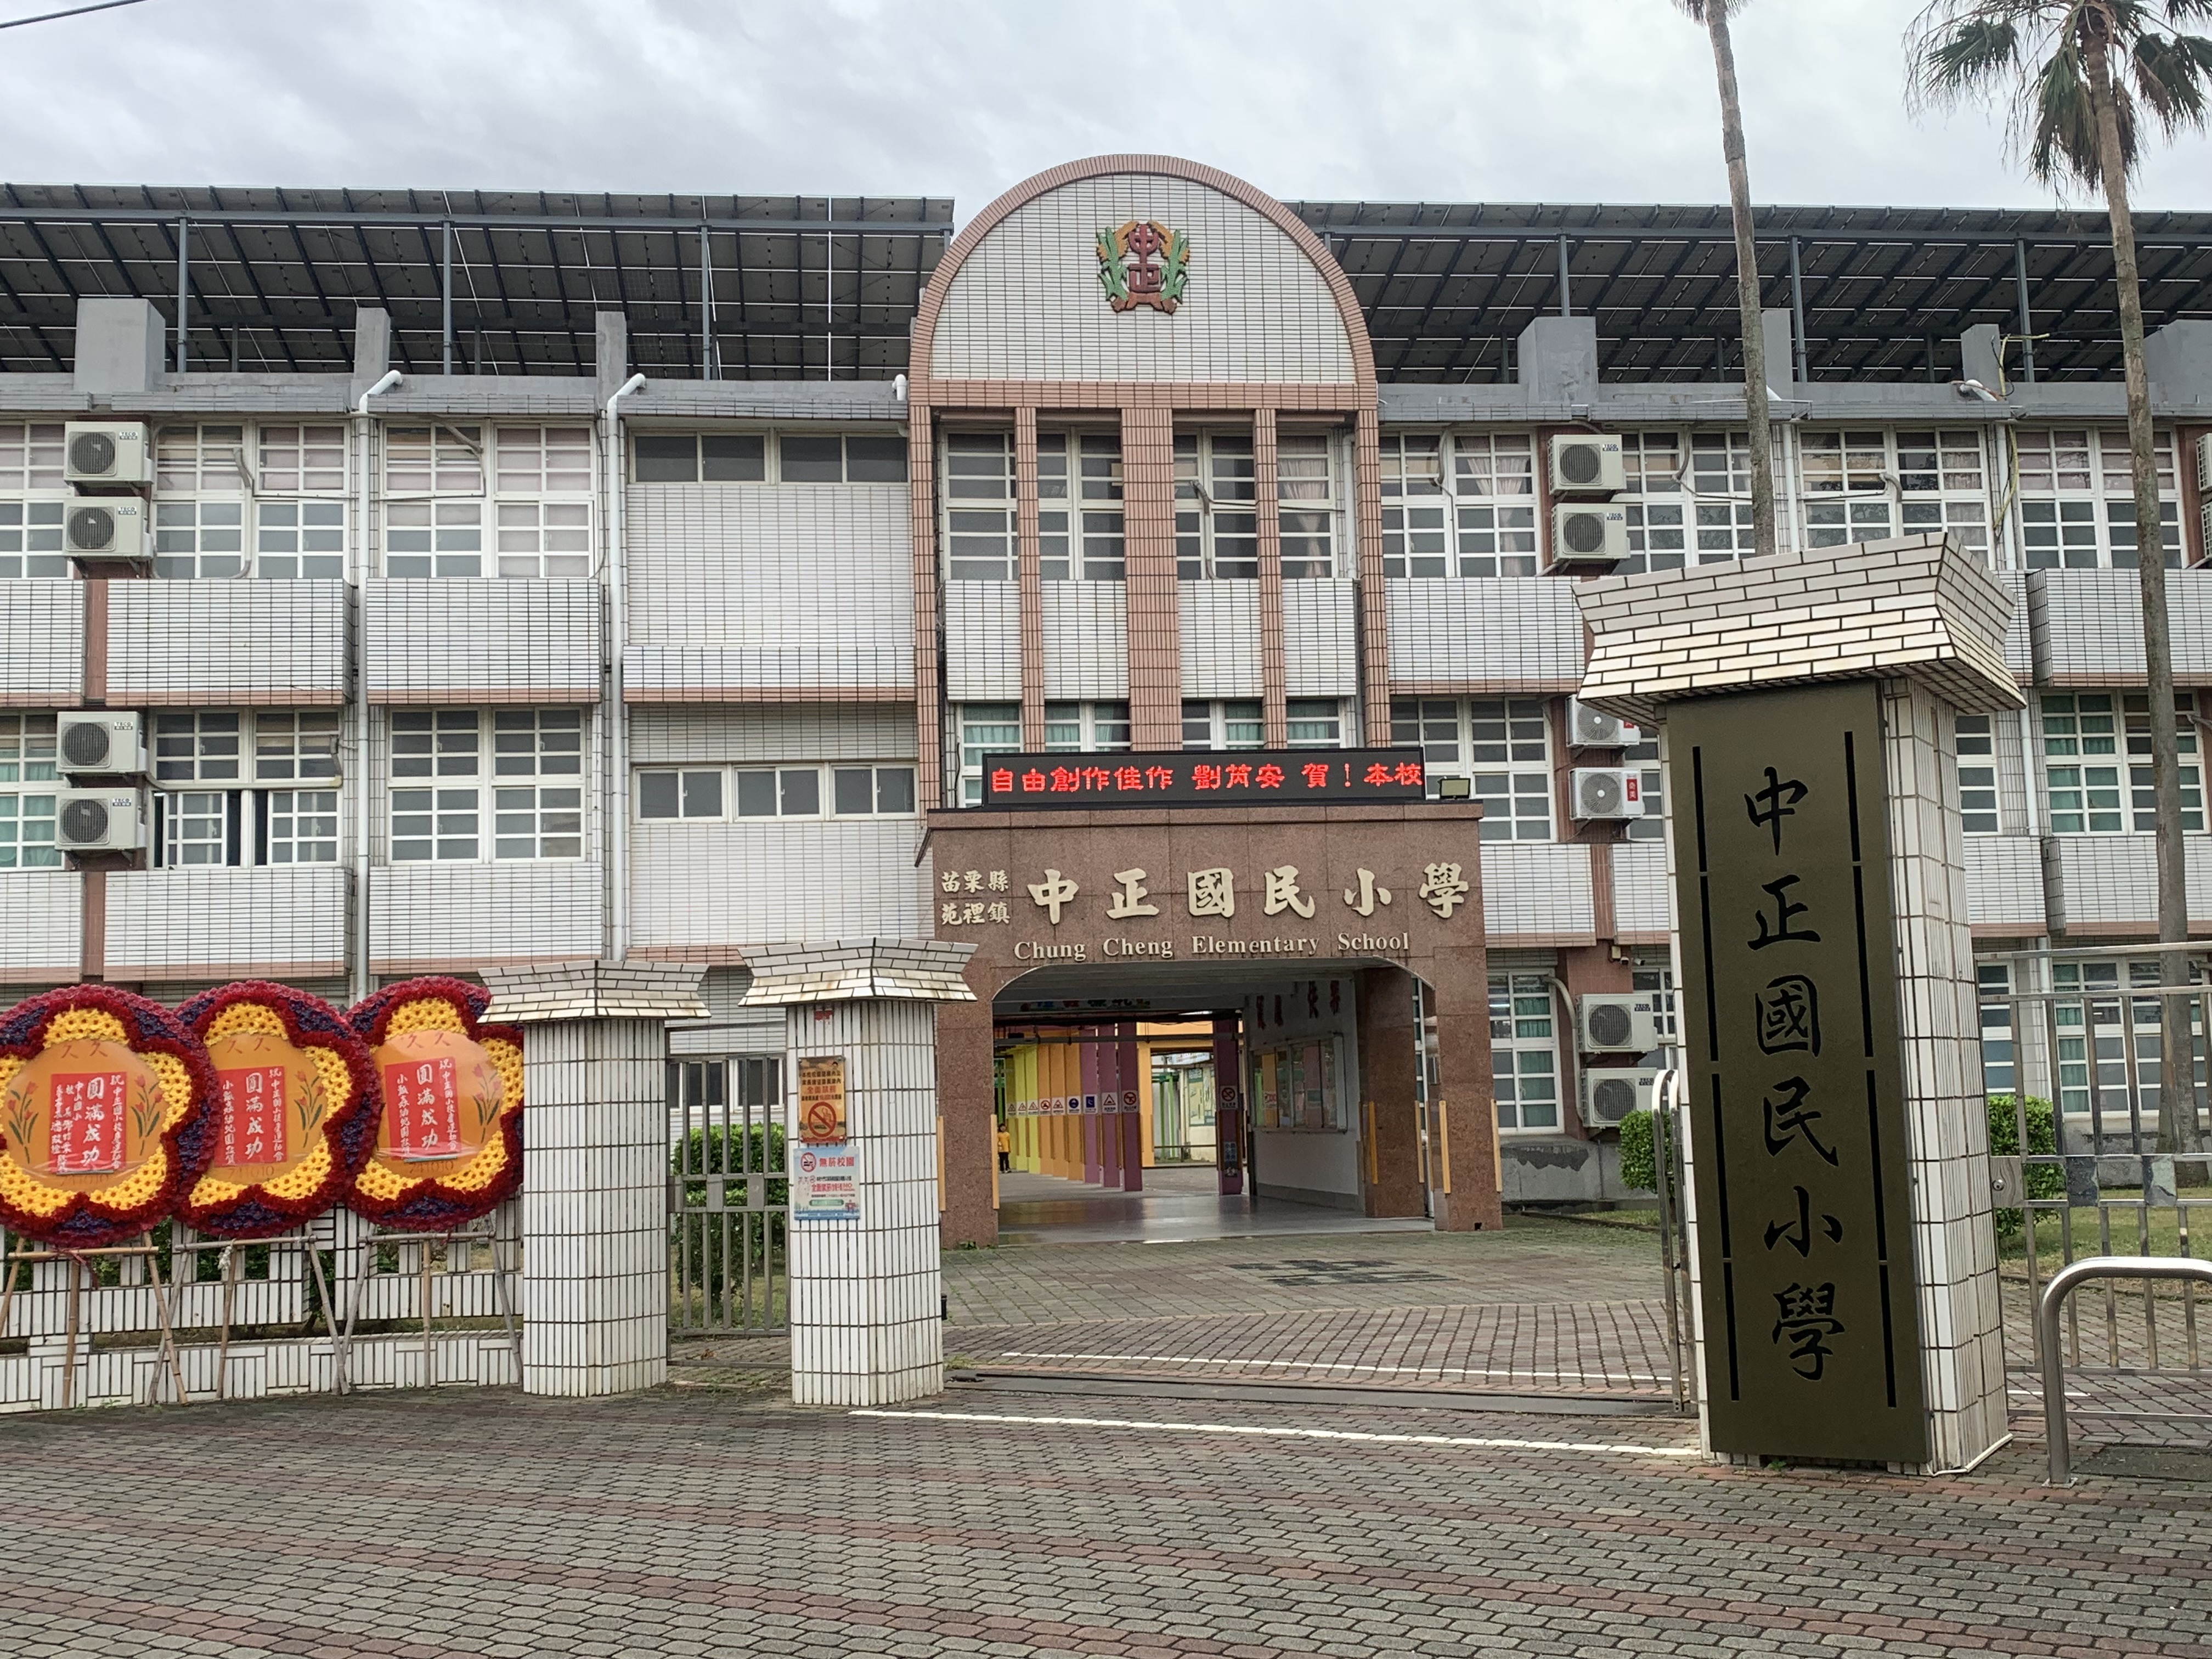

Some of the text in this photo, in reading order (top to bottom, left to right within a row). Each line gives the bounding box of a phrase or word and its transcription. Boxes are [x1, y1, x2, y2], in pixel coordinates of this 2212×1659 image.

[991, 766, 1173, 792] 自由創作佳作
[941, 870, 1008, 893] 苗栗縣
[1027, 862, 1469, 924] 中正國民小學
[941, 901, 1011, 926] 苑裡鎮
[1014, 932, 1409, 962] Chung Cheng Elementary School
[1744, 766, 1844, 1381] 中正國民小學
[81, 1077, 105, 1167] 圓滿成功
[245, 1073, 263, 1159] 圓滿成功
[416, 1064, 439, 1150] 圓滿成功
[820, 1157, 854, 1167] 無菸校園
